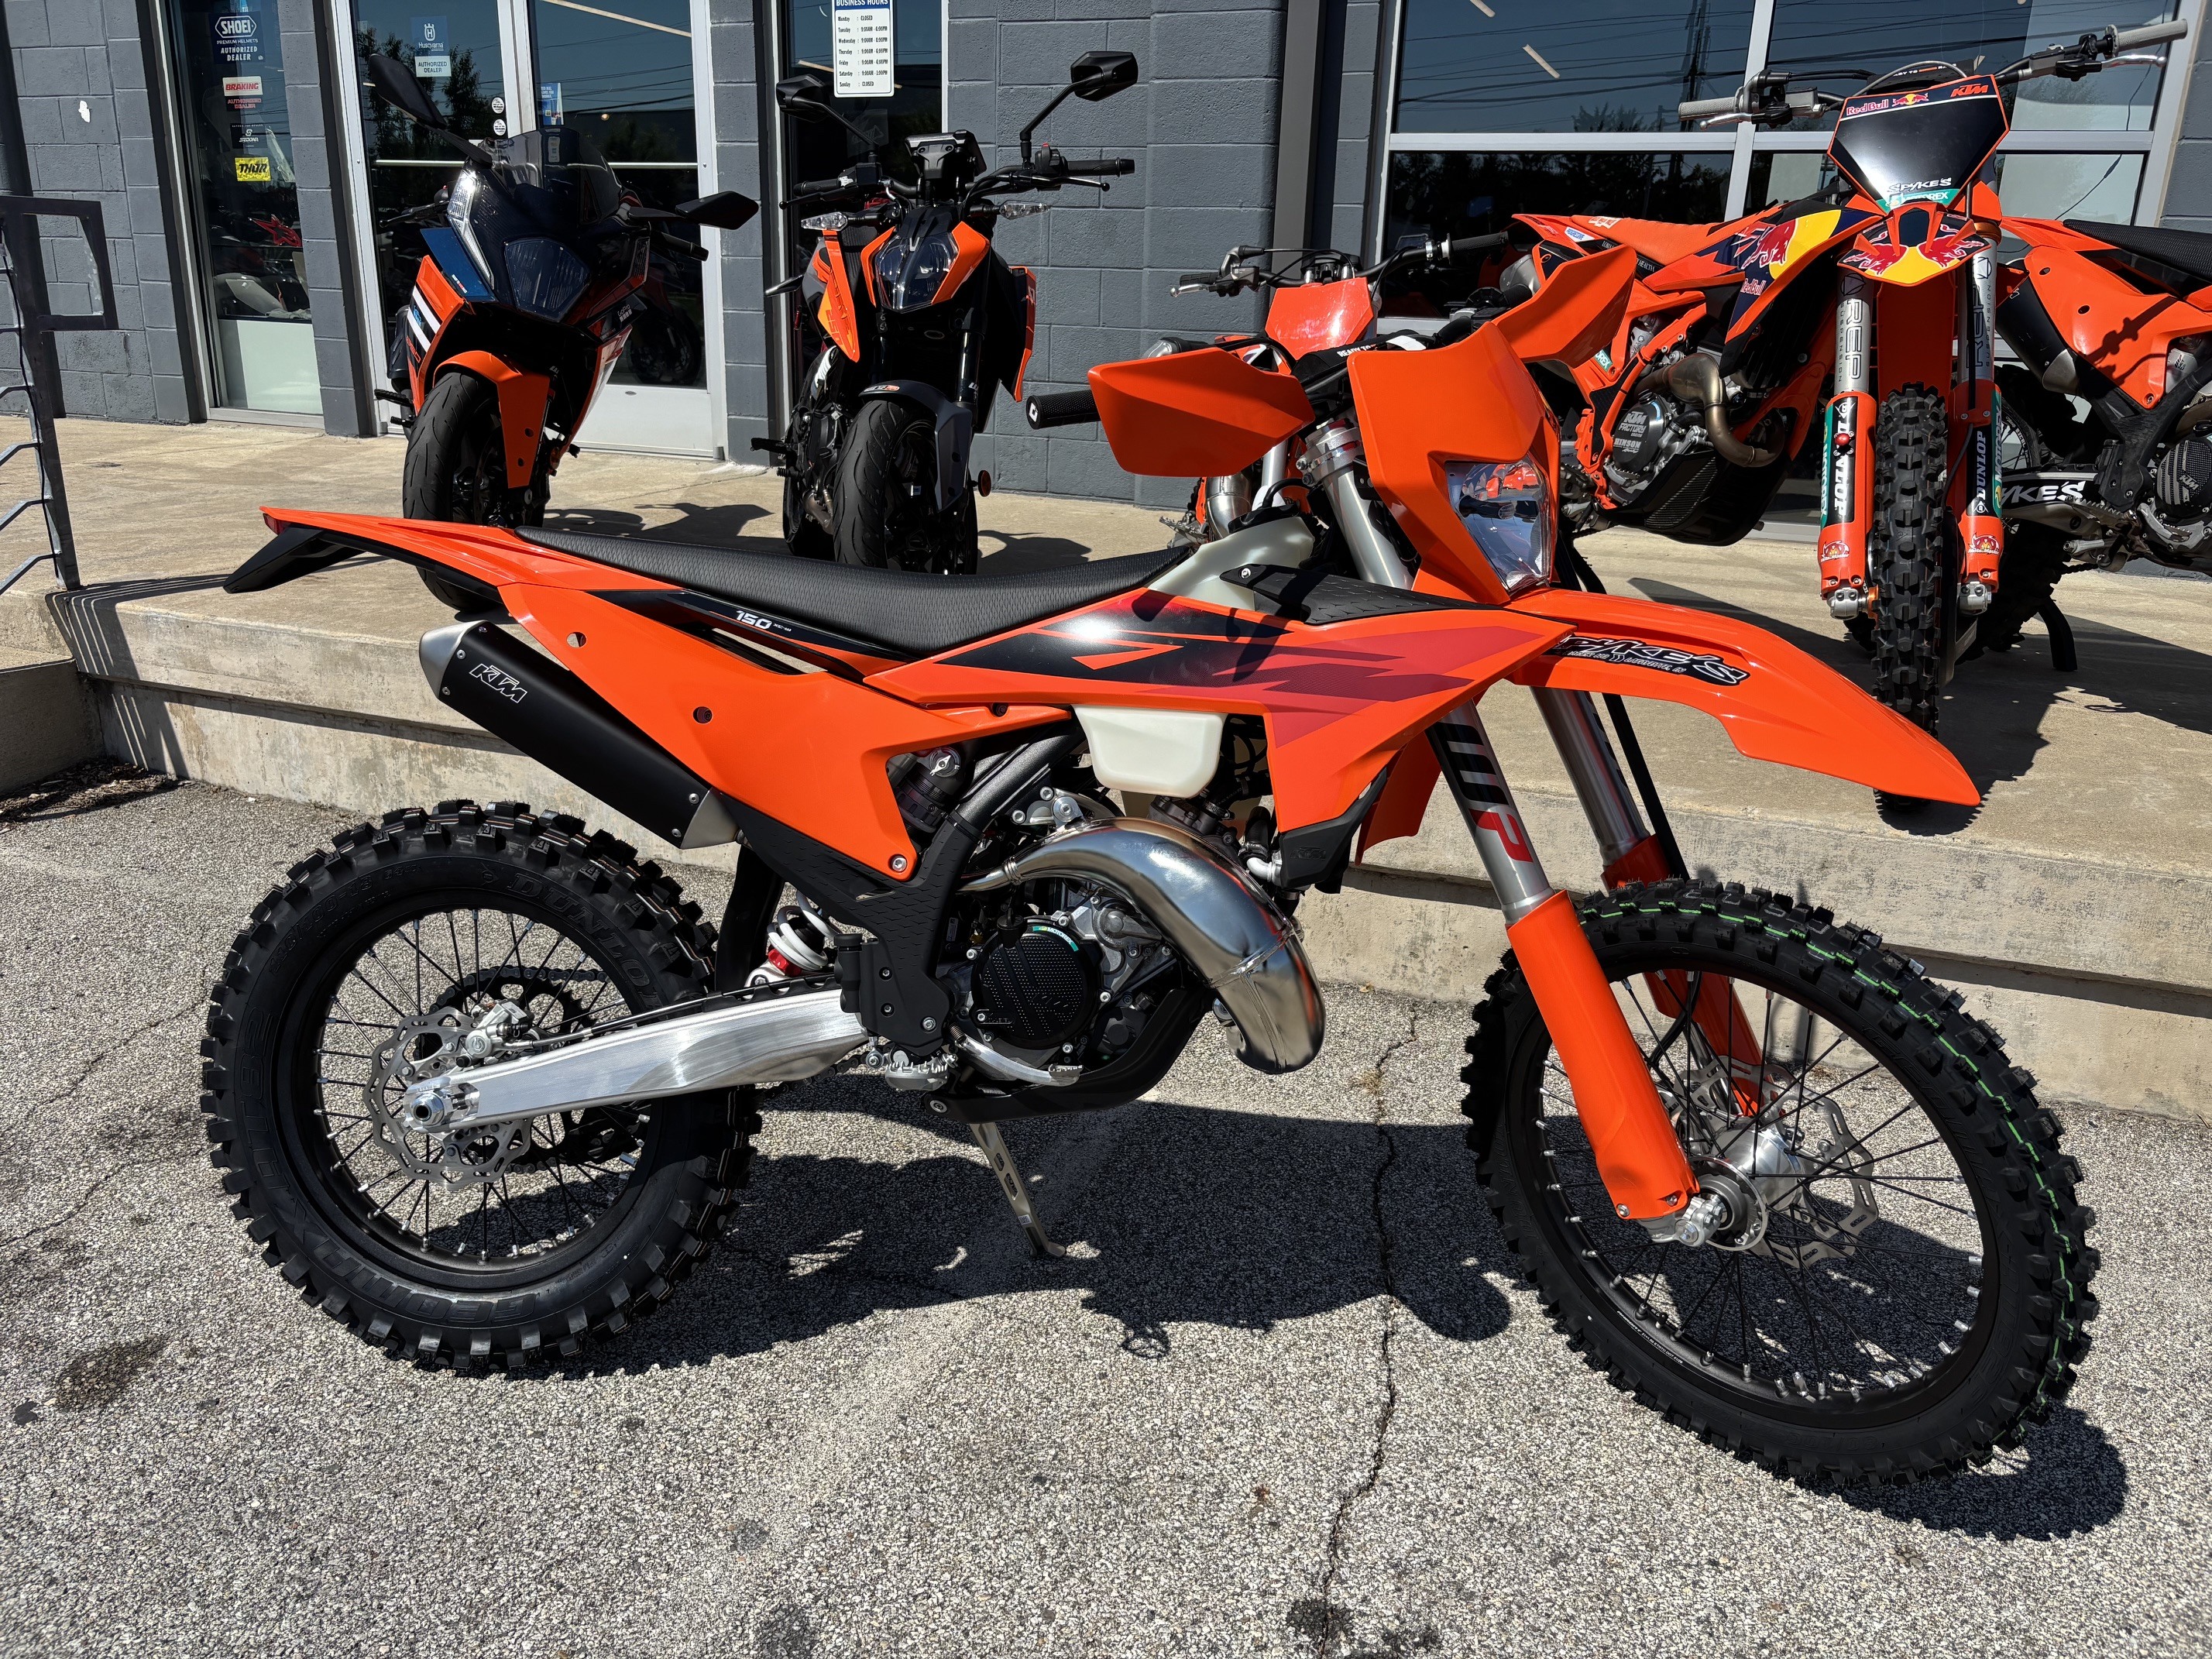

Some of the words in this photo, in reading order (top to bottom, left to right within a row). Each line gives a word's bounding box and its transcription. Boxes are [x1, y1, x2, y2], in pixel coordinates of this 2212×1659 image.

[221, 19, 252, 34] SHOEI
[1950, 84, 1989, 98] KTM
[1846, 102, 1867, 115] Red
[1867, 99, 1888, 112] Bull
[239, 163, 268, 173] THOR
[1887, 177, 1951, 194] SPYKE'S
[617, 304, 631, 317] GoPro
[1846, 298, 1863, 380] REP
[1337, 347, 1361, 357] READY
[1623, 411, 1647, 424] KTM
[1619, 422, 1647, 434] FACTORY
[1613, 438, 1641, 448] HINSON
[1977, 431, 1987, 500] DUNLOP
[2179, 475, 2200, 490] KTM
[736, 610, 772, 630] 150
[469, 663, 527, 703] KTM
[1047, 926, 1073, 945] MOTOREX
